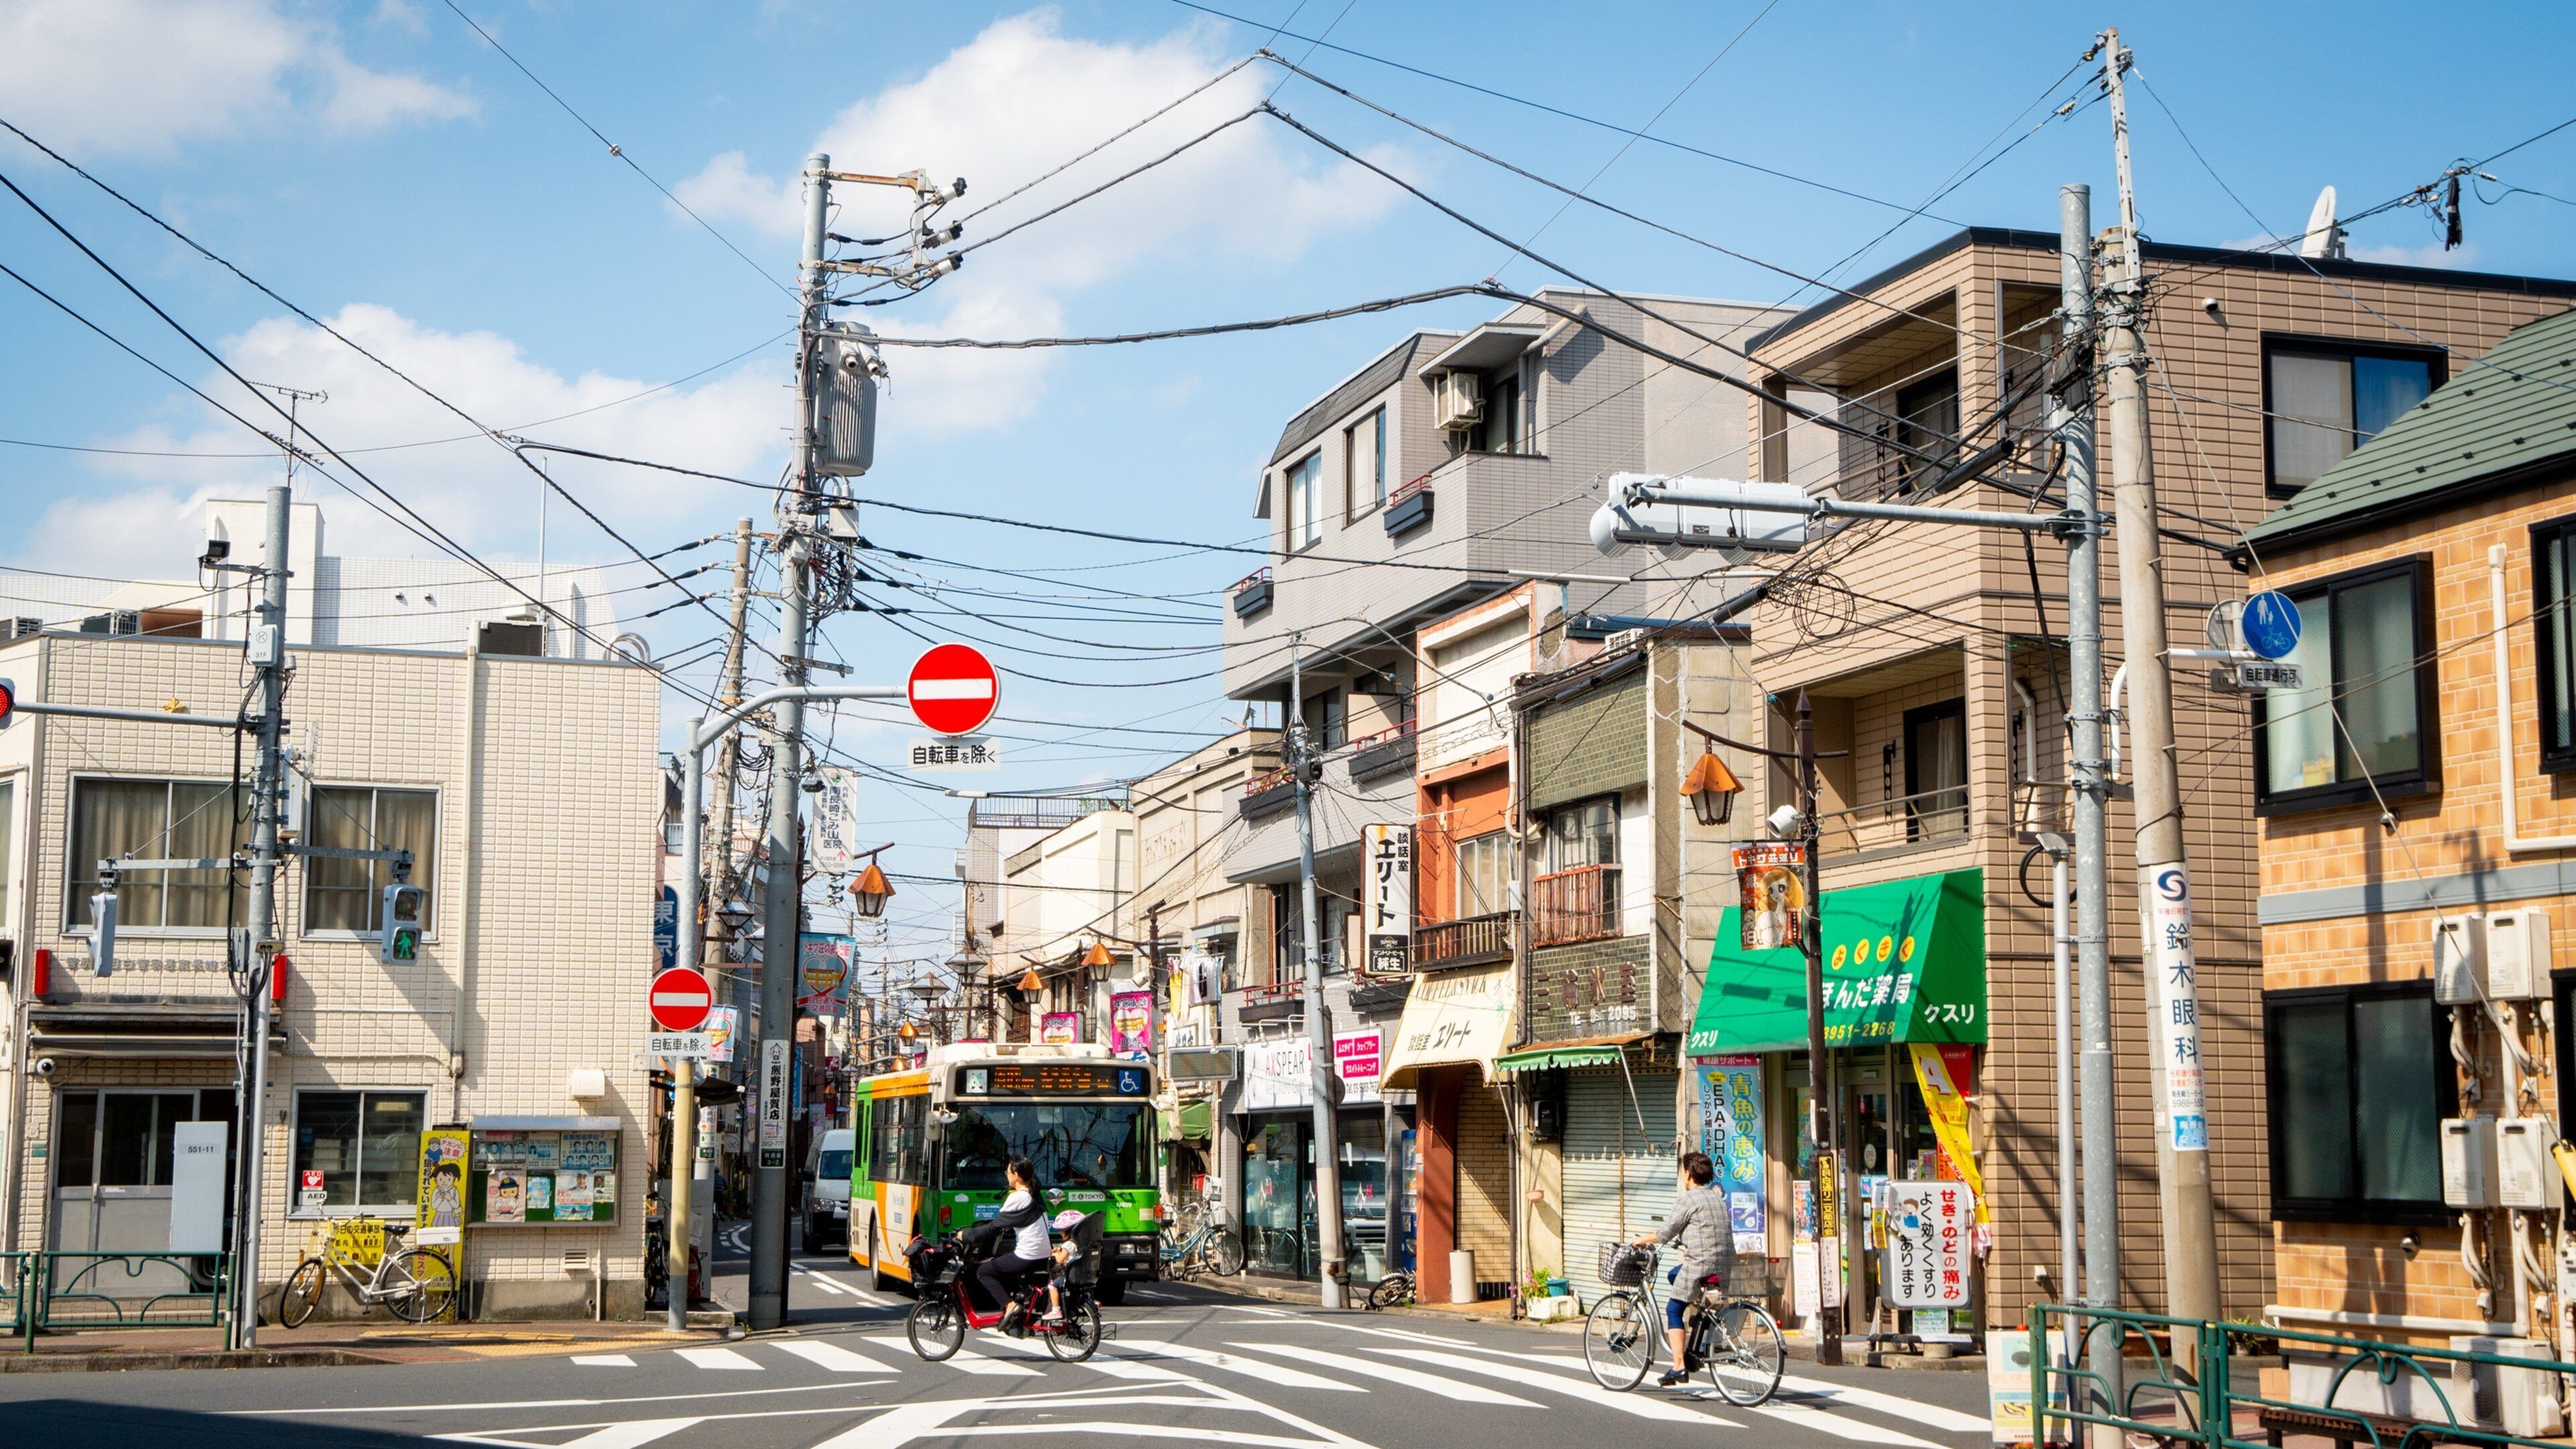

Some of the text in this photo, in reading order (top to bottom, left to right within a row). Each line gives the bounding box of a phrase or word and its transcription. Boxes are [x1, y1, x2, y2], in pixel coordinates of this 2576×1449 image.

[2246, 669, 2297, 683] 自転車通行可
[913, 745, 996, 765] 自転車を除く
[1397, 833, 1409, 871] 談話室
[1375, 839, 1396, 928] エリート
[1833, 939, 1914, 968] よくきく
[2165, 923, 2198, 1064] 鈴木眼科
[1607, 1005, 1637, 1023] 2095
[1924, 1004, 1975, 1024] クスリ
[652, 1038, 707, 1052] 自転車を除く
[1432, 1020, 1472, 1050] エリート
[1690, 1030, 1719, 1049] クスリ
[1265, 1051, 1305, 1077] AXSPEAR
[1703, 1056, 1752, 1066] 健康サポート
[769, 1065, 782, 1120] 熊野屋質店
[1713, 1083, 1726, 1177] EPA・DHAを
[1729, 1072, 1758, 1184] 青魚の恵み
[188, 1145, 214, 1154] 551-11
[443, 1148, 461, 1158] 注意
[1921, 1191, 1937, 1299] よく効くくすり
[1940, 1189, 1960, 1300] せき・のどの痛み
[1900, 1236, 1915, 1299] あります
